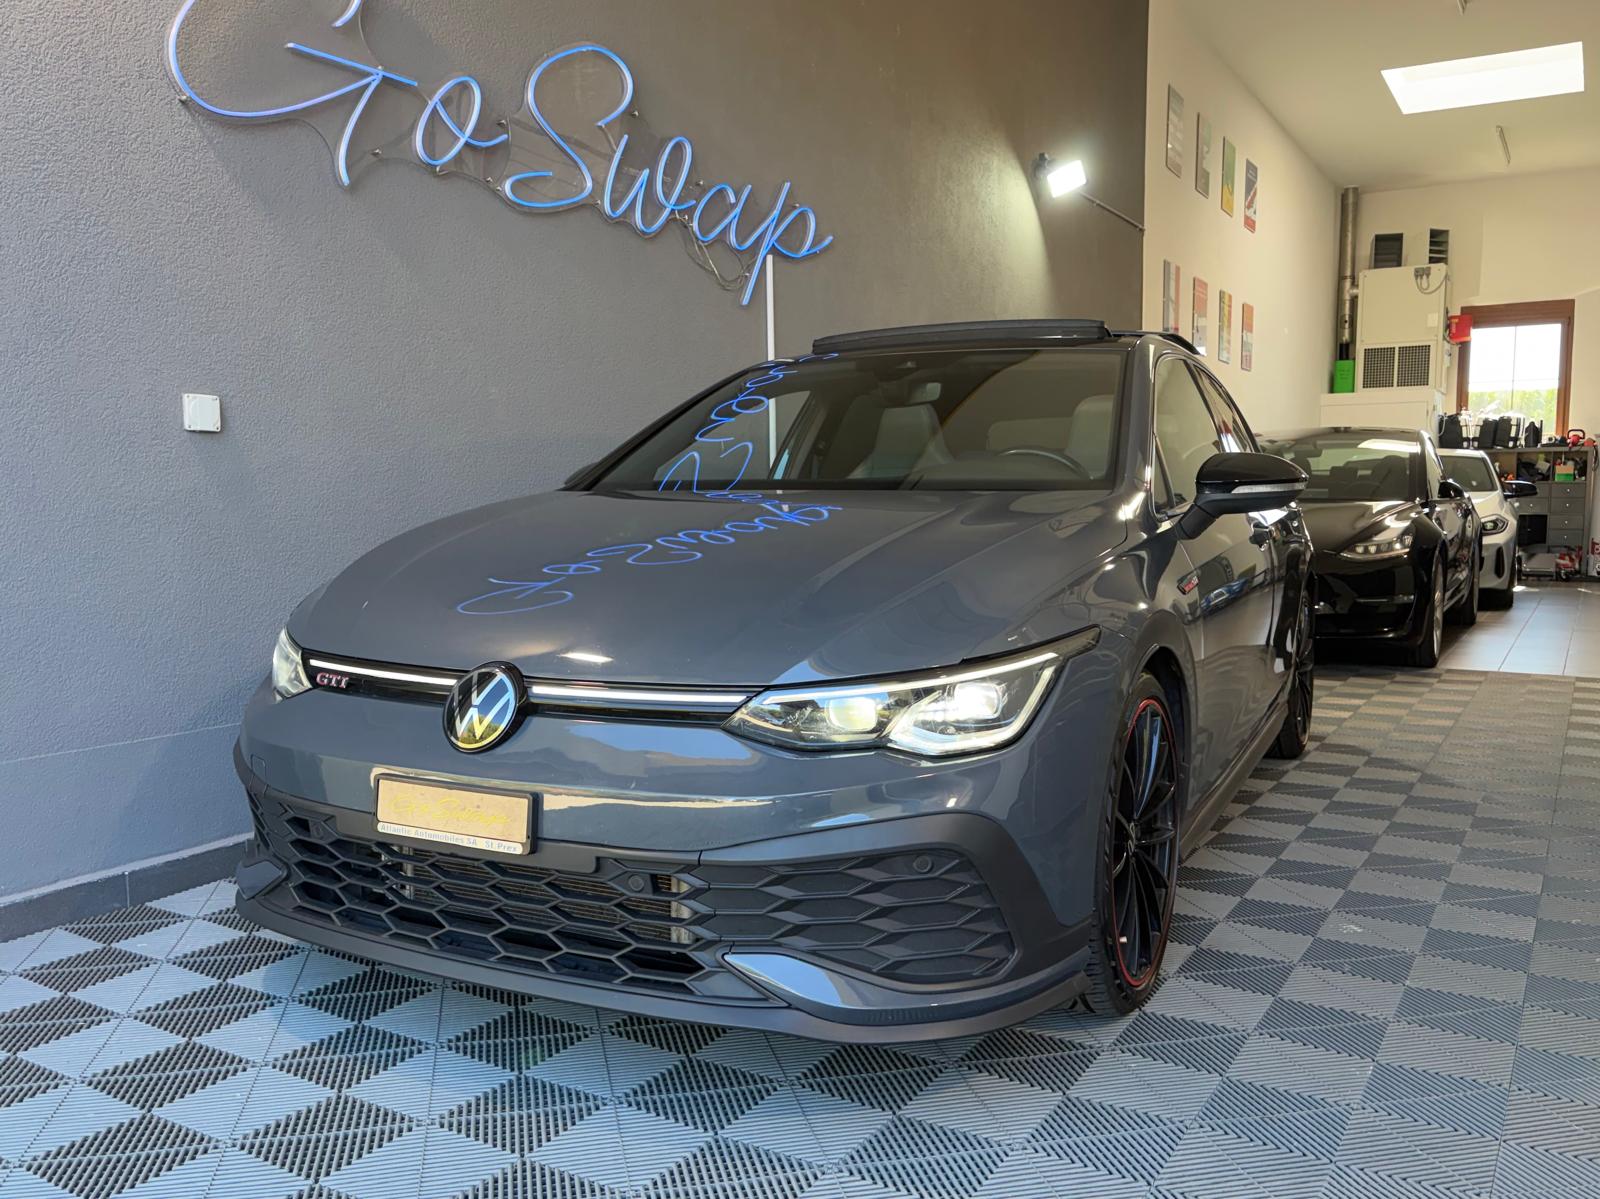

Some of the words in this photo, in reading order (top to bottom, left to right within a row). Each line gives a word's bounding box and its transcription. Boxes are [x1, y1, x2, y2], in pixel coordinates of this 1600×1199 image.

[315, 671, 349, 689] GTI
[380, 823, 411, 836] Atlantic
[414, 828, 464, 845] Automobiles
[466, 838, 477, 847] SA
